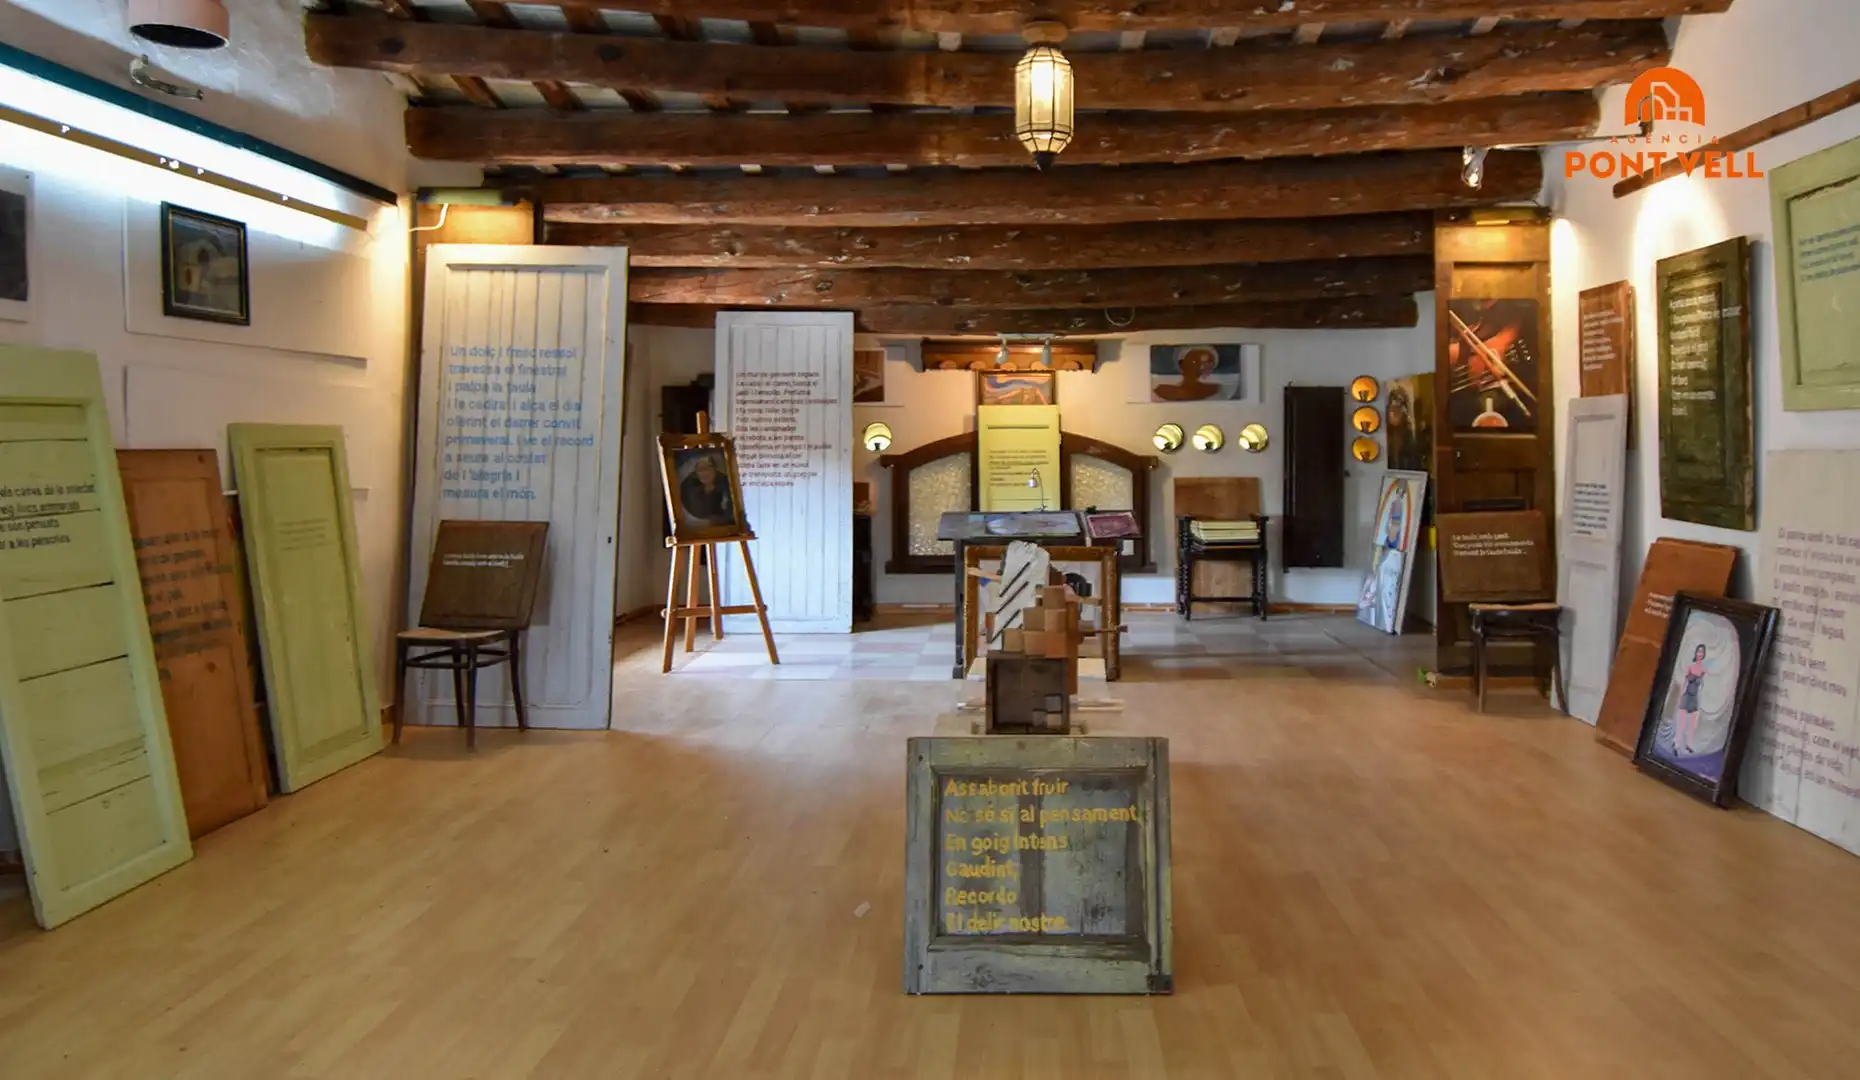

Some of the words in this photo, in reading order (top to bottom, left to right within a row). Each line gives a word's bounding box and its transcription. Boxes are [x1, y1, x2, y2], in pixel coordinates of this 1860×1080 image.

[1032, 777, 1070, 797] fruir
[1020, 805, 1036, 824] al
[946, 833, 967, 852] En
[971, 833, 1011, 857] goig
[945, 886, 1018, 907] Recordo
[967, 911, 1006, 932] delir
